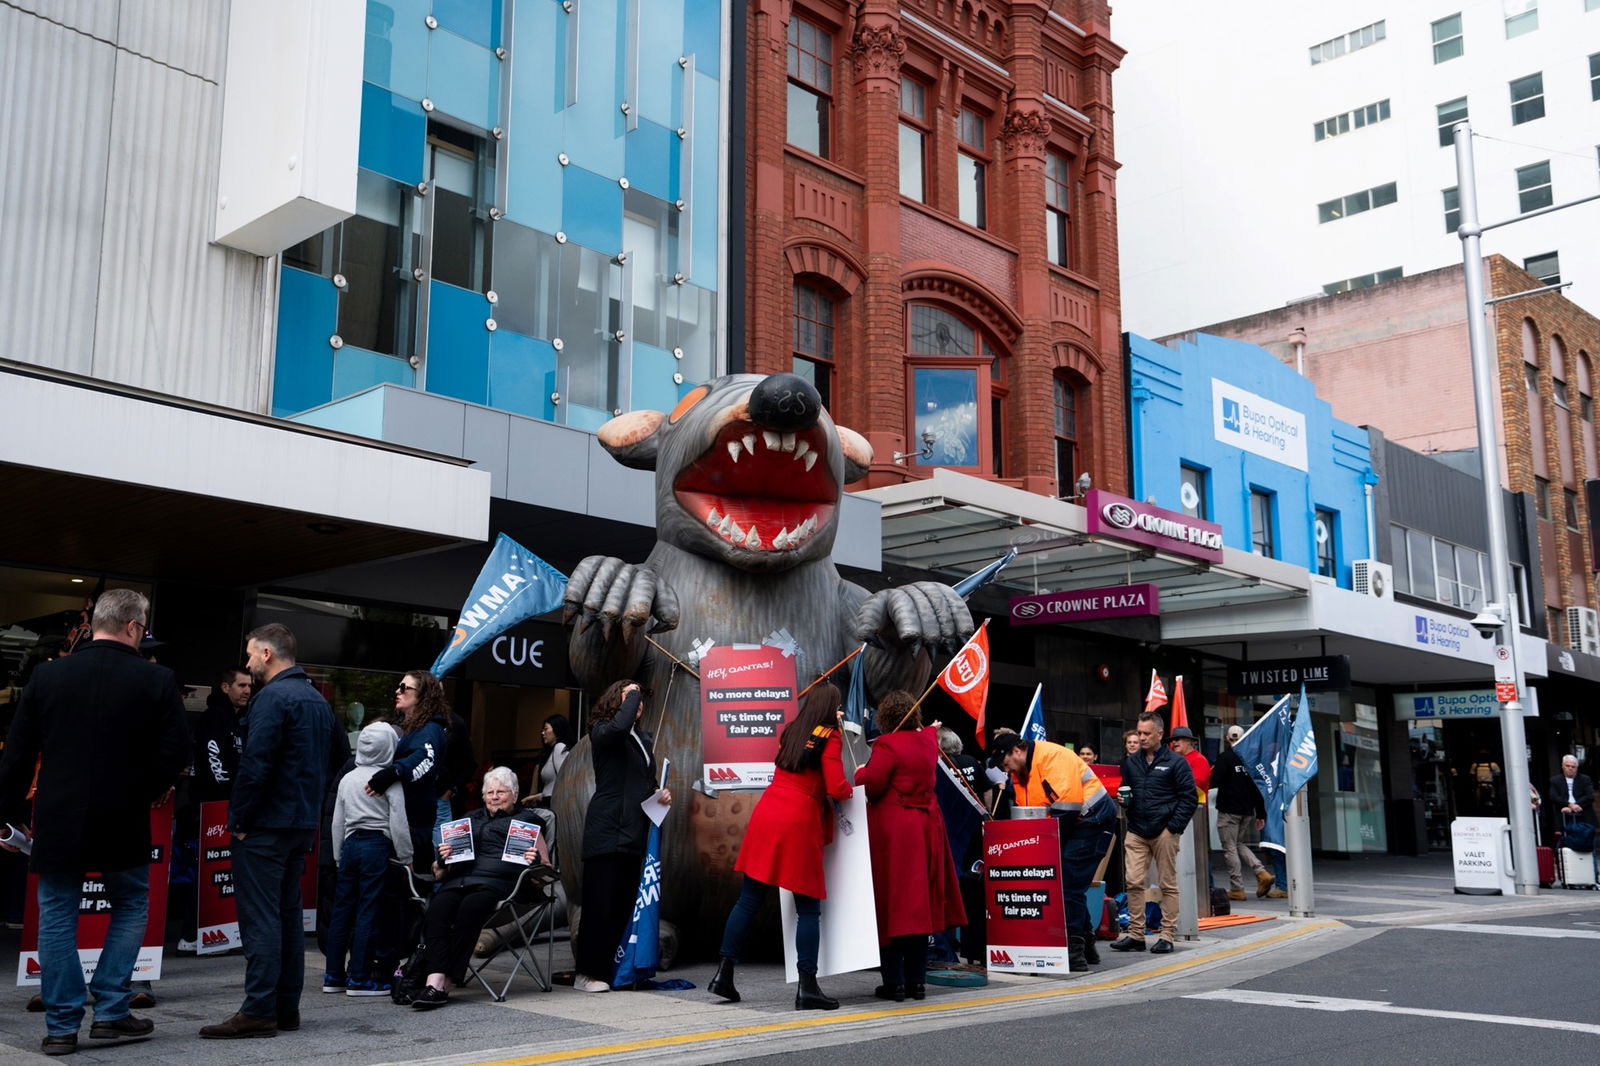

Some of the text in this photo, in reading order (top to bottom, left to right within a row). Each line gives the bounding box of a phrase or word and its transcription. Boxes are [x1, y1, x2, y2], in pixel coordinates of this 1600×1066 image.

[1243, 405, 1298, 439] Bupa Optical
[1243, 424, 1285, 451] & Hearing
[1137, 513, 1224, 550] CROWNE PLAZA
[1047, 593, 1145, 614] CROWNE PLAZA
[1429, 619, 1469, 638] Bupa Optical
[1430, 635, 1460, 652] & Hearing
[492, 636, 544, 668] CUE
[707, 660, 774, 680] HEY, QANTAS!
[956, 653, 975, 682] AEU
[1241, 667, 1329, 685] TWISTED LIME
[709, 689, 789, 700] No more delays!
[1437, 694, 1464, 708] Bupa
[1440, 704, 1492, 716] & Hearing
[720, 713, 781, 722] It's time for
[730, 725, 773, 736] fair pay.
[1002, 836, 1040, 850] QANTAS!
[207, 850, 219, 859] No
[1459, 860, 1492, 868] PARKING
[214, 872, 230, 882] It's
[989, 867, 1053, 879] No more delays!
[997, 893, 1047, 902] It's time for
[1004, 906, 1040, 917] fair pay.
